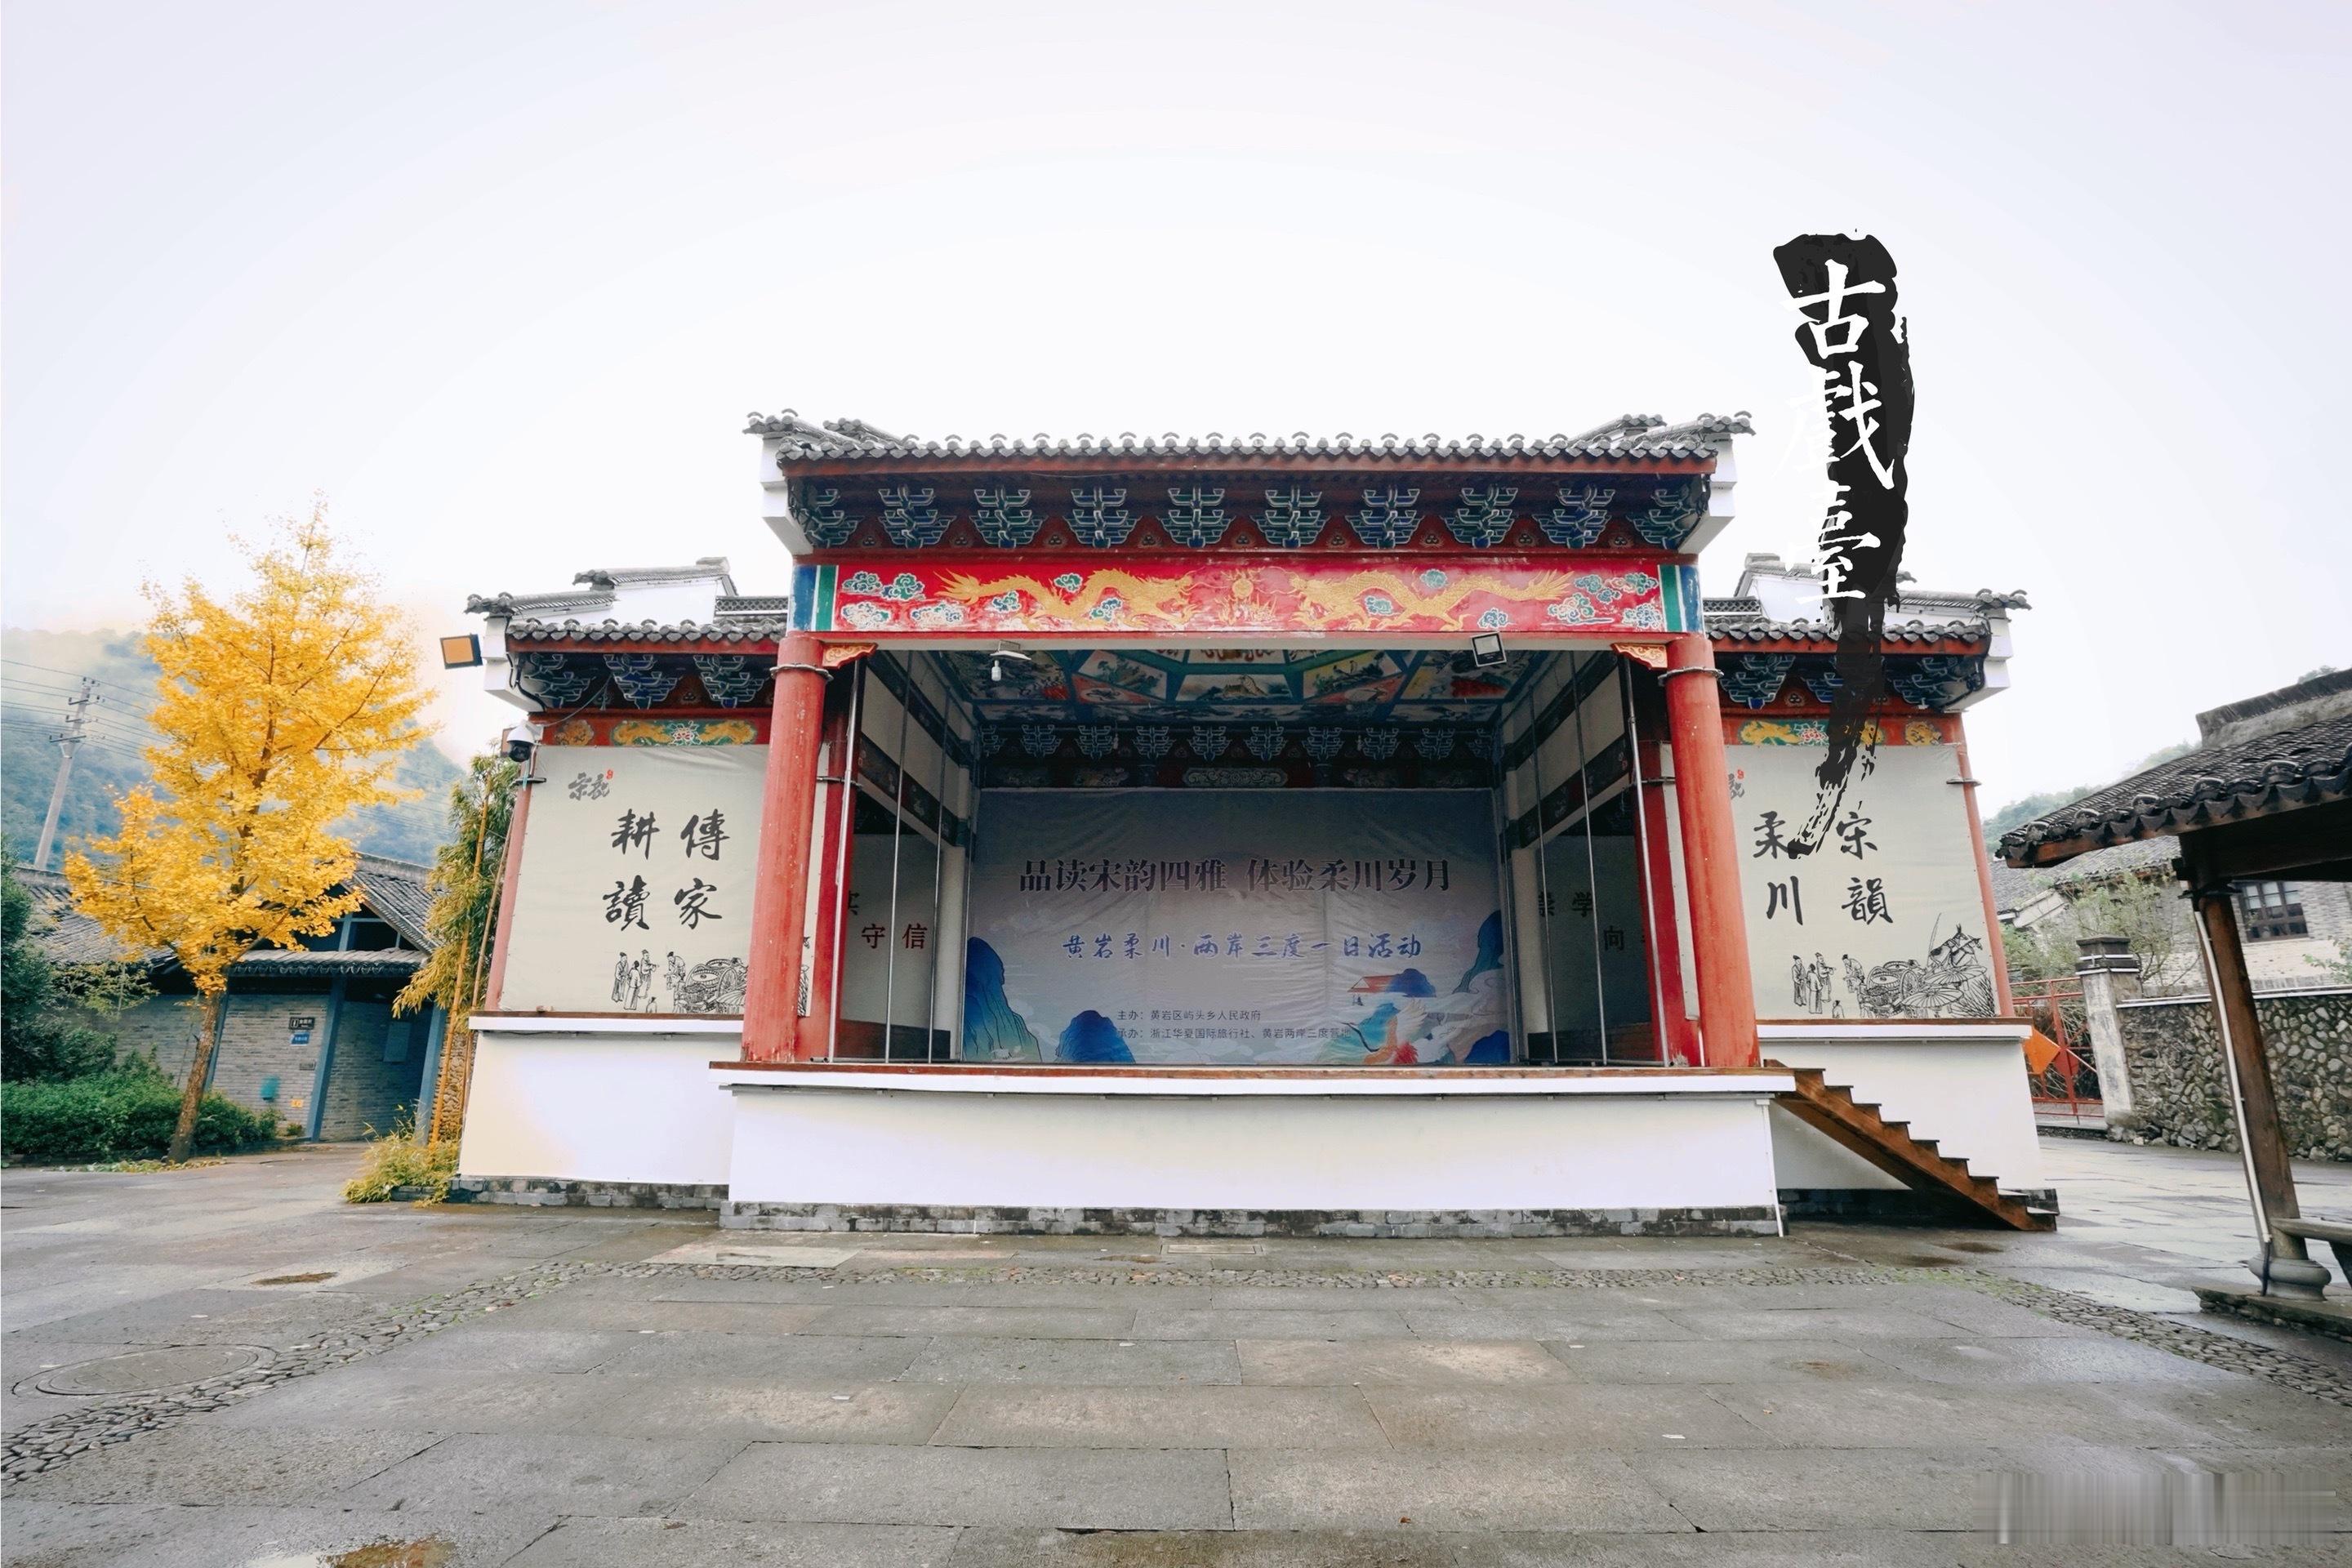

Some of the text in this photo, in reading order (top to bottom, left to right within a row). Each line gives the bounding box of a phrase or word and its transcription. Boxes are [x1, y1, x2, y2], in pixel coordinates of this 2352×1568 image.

[1020, 858, 1450, 892] 品读宋韵四雅 体验柔川岁月
